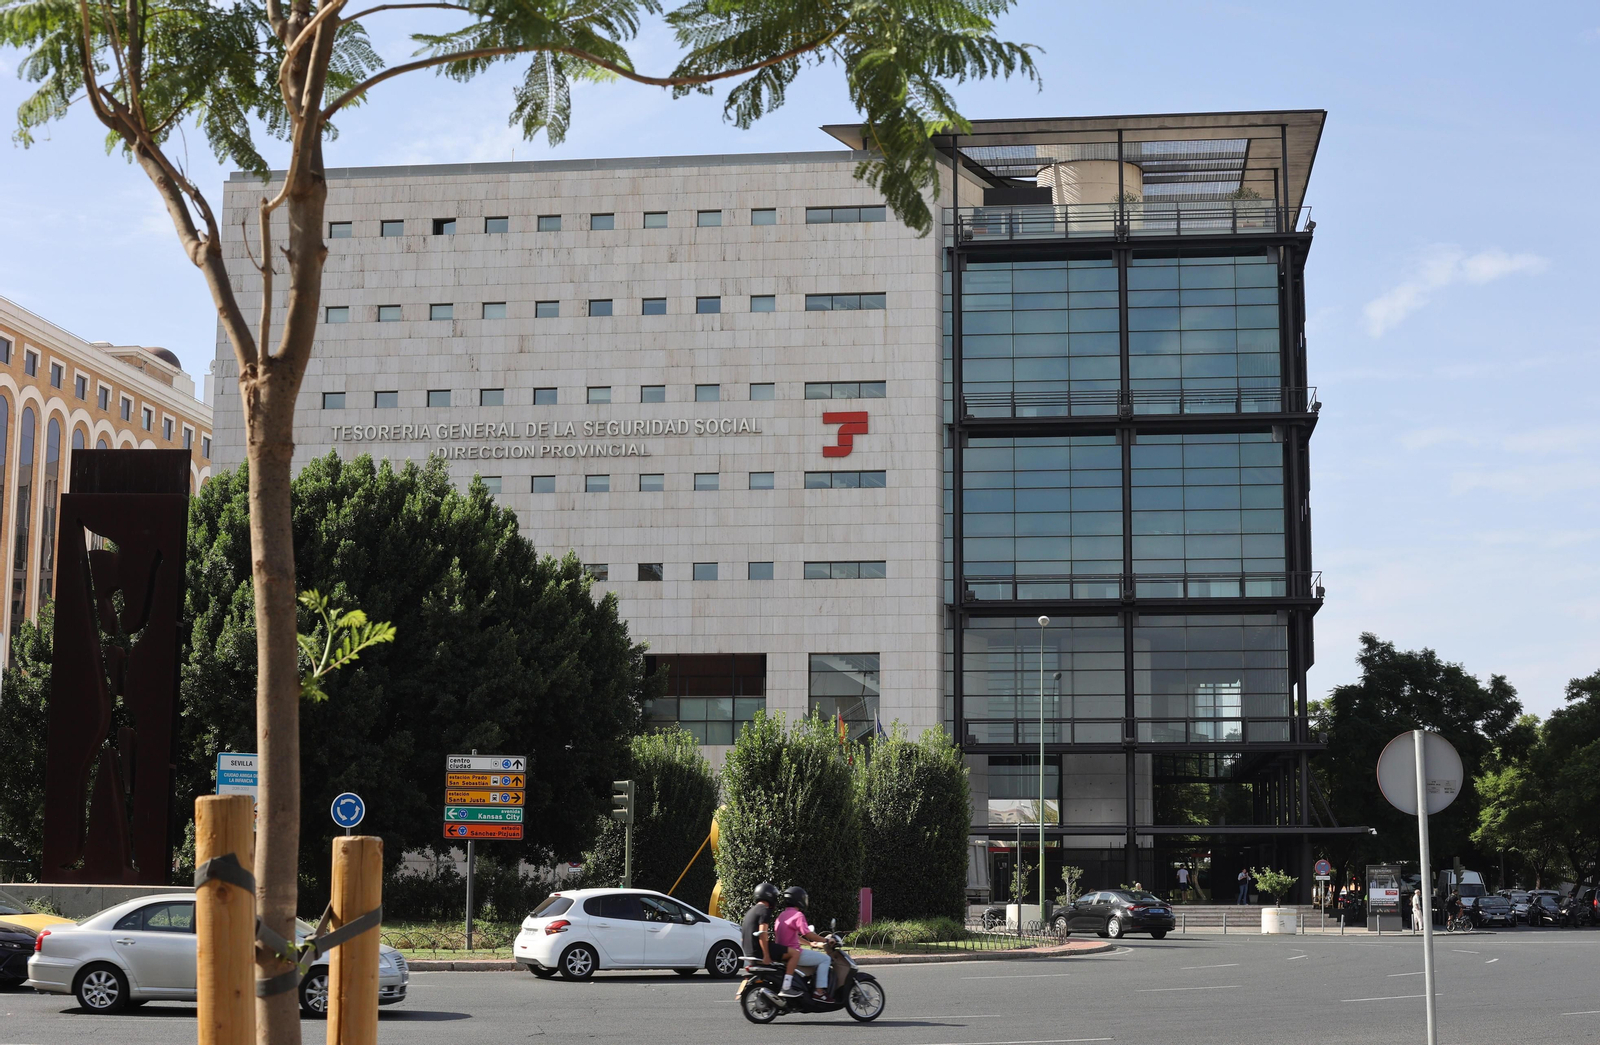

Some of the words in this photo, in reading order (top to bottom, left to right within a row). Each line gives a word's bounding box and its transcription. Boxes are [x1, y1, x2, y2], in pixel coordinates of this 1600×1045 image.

[331, 423, 432, 441] TESORERIA
[436, 422, 520, 440] GENERAL
[526, 421, 549, 438] DE
[554, 420, 577, 437] LA
[583, 418, 689, 437] SEGURIDAD
[694, 417, 762, 435] SOCIAL
[436, 445, 536, 460] DIRECCION
[540, 443, 651, 459] PROVINCIAL
